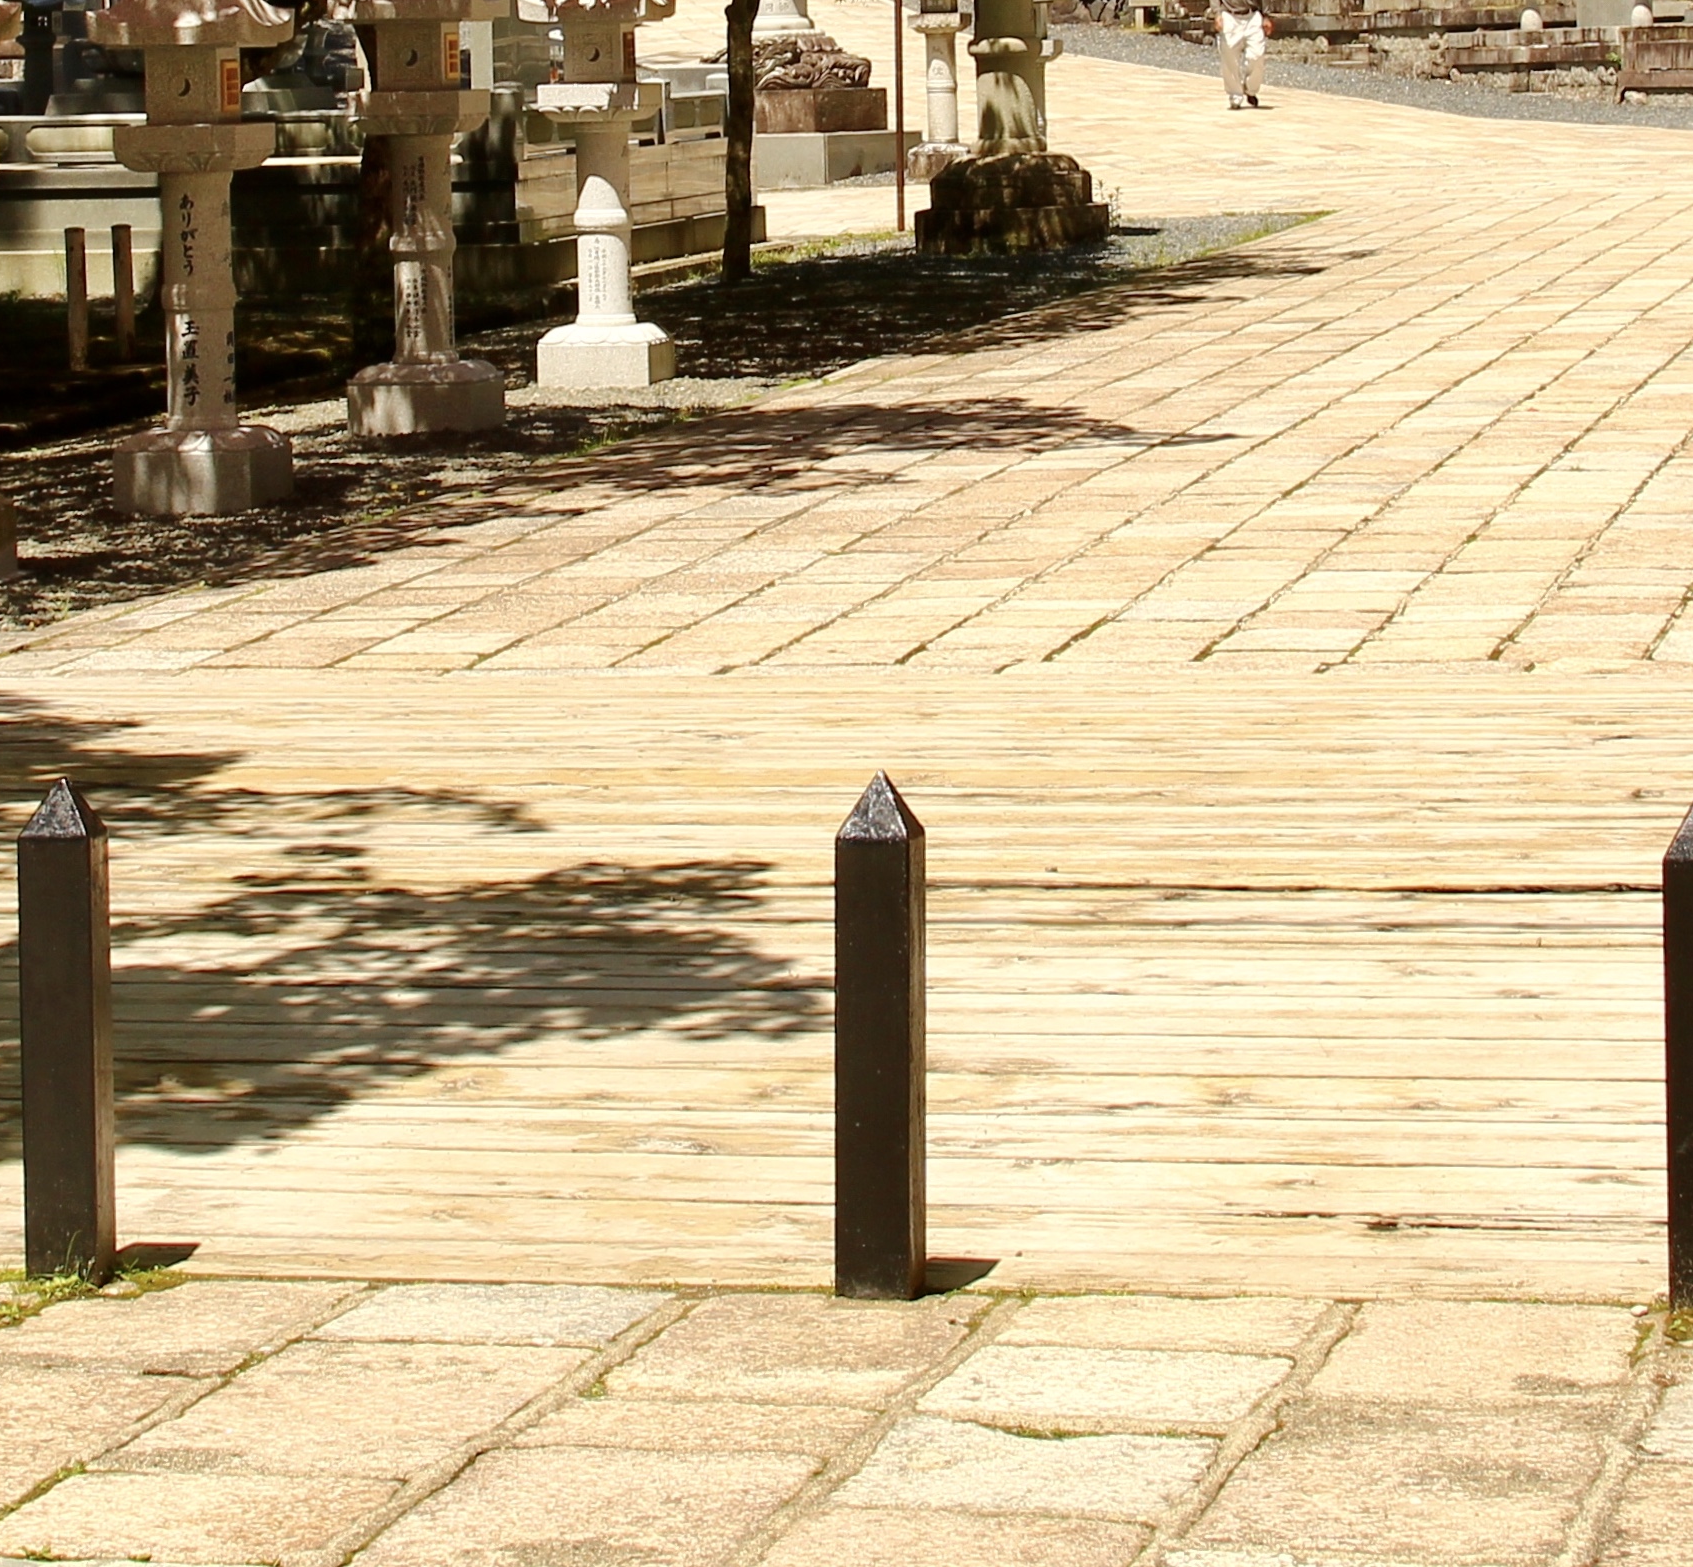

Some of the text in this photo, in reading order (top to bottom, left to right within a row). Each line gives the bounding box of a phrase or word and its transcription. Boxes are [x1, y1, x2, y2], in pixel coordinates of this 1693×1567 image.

[179, 193, 198, 276] ありがとう
